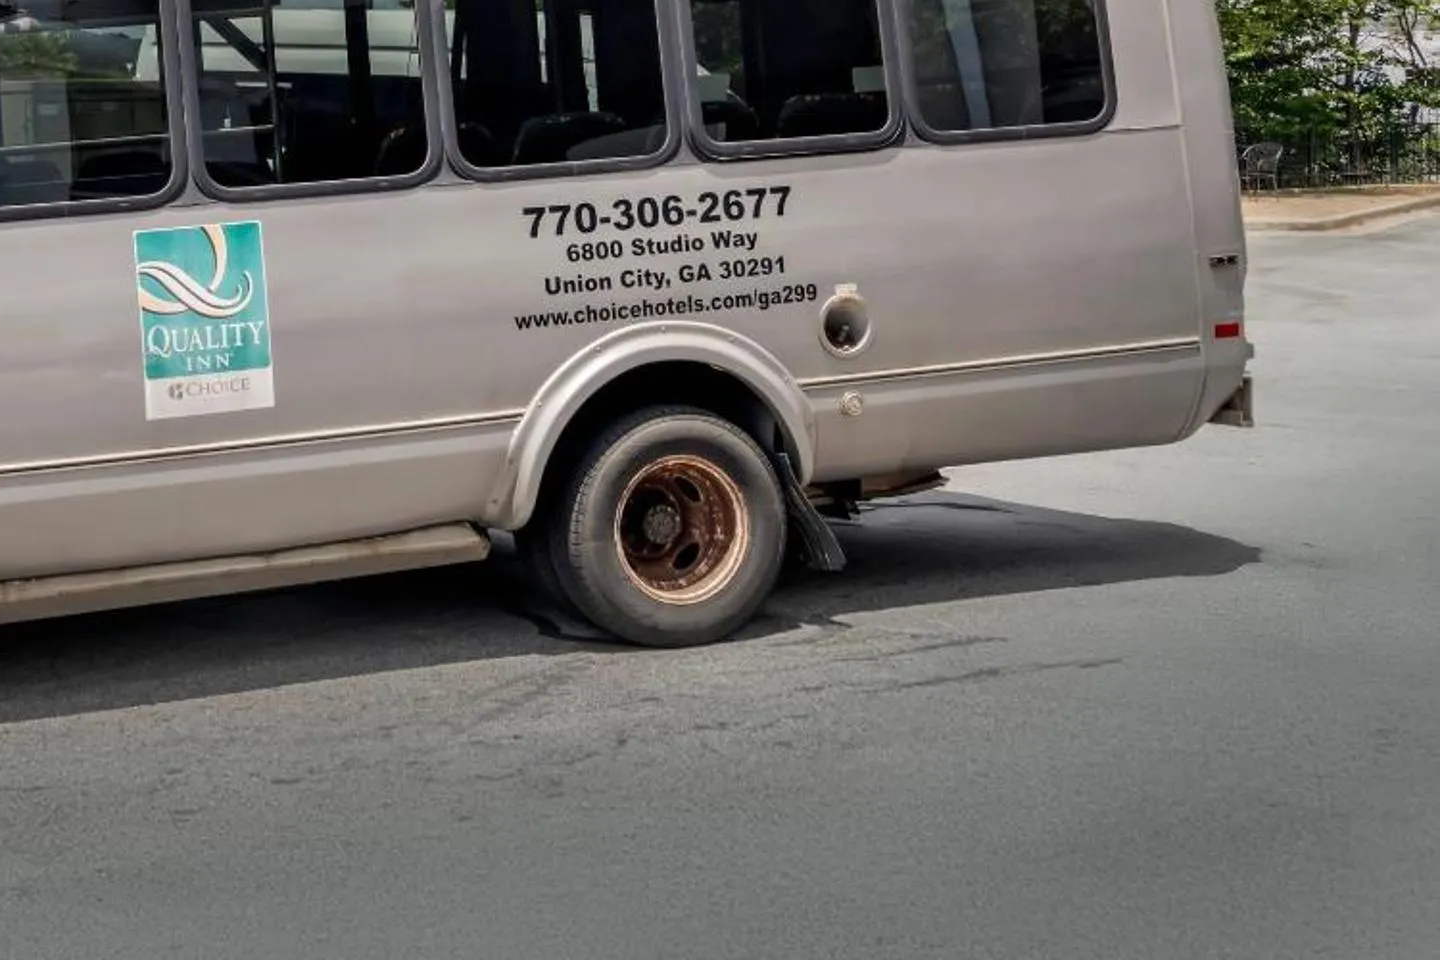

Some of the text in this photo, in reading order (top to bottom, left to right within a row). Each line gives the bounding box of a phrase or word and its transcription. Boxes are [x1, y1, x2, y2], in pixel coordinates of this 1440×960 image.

[522, 185, 792, 239] 770-306-2677
[566, 230, 758, 263] 6800 Studio Way
[544, 255, 786, 295] Union City, GA 30291
[514, 283, 818, 331] www.choicehotels.com/ga299
[146, 320, 265, 358] QUALITY
[186, 353, 230, 372] INN
[185, 377, 251, 397] CHOICE
